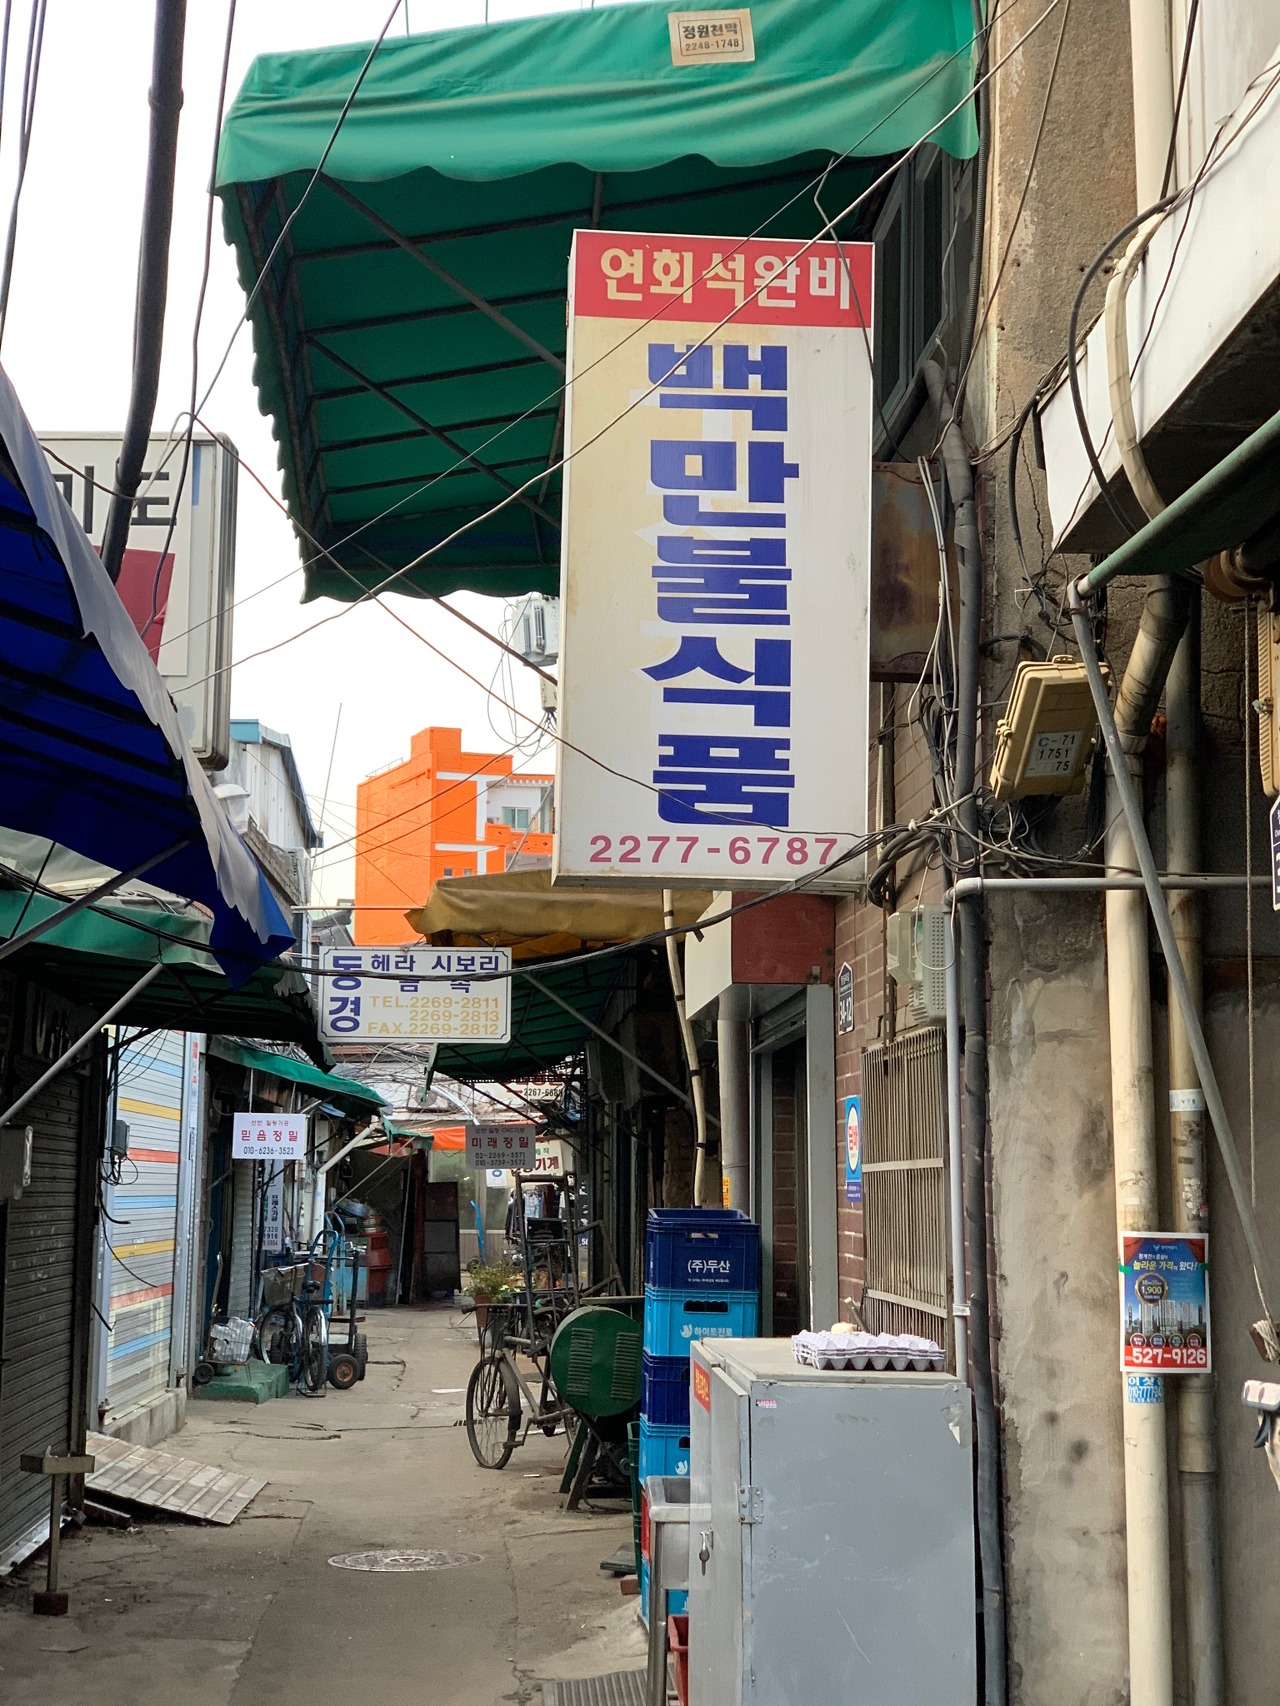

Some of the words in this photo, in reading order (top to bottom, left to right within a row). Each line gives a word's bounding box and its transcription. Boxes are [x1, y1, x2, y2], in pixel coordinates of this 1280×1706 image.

[682, 22, 738, 40] 정원천막
[600, 247, 850, 310] 연회석완비
[640, 342, 800, 828] 백만불식품
[1039, 748, 1070, 760] 1751
[589, 834, 838, 866] 2277-6787
[371, 954, 416, 972] 헤라
[431, 955, 500, 974] 시보리
[328, 955, 362, 1033] 동경
[369, 995, 500, 1010] TEL.2269-2811
[408, 1009, 500, 1023] 2269-2813
[367, 1022, 500, 1036] FAX.2269-2812
[243, 1146, 295, 1155] 010-6236-3523
[471, 1136, 529, 1149] 미래정밀
[687, 1259, 731, 1274] (주)두산
[1132, 1347, 1206, 1365] 527-9126
